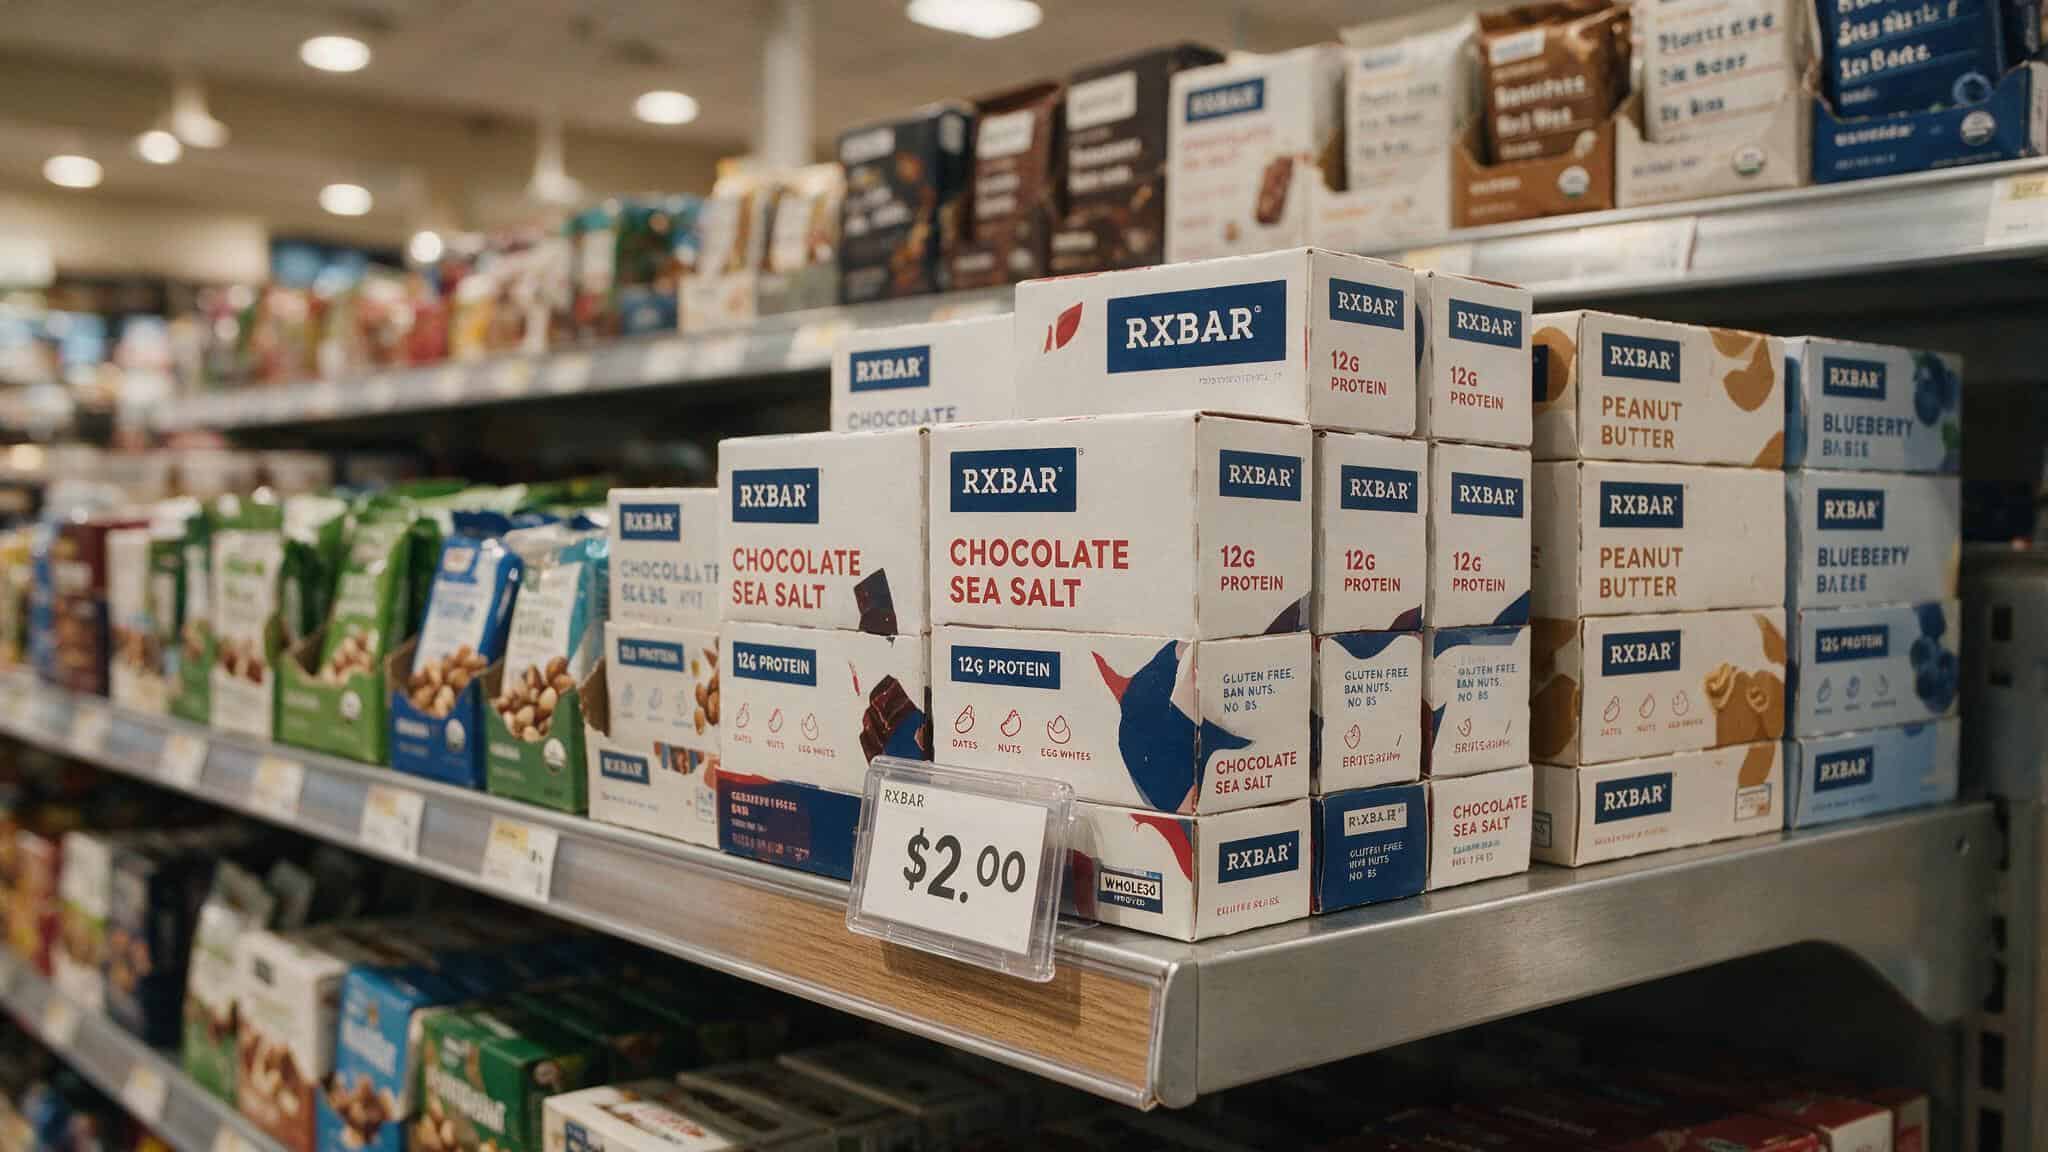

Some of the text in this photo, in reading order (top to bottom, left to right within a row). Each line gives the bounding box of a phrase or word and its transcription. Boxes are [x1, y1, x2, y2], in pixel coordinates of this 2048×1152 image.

[1337, 290, 1397, 318] RXBAR
[1125, 307, 1254, 349] RXBAR
[1456, 310, 1515, 338] RXBAR
[1331, 350, 1359, 372] 12G
[1609, 344, 1672, 371] RXBAR
[855, 356, 921, 383] RXBAR
[1451, 366, 1478, 387] 12G
[1829, 366, 1880, 389] RXBAR
[1331, 377, 1387, 396] PROTEIN
[1451, 391, 1504, 411] PROTEIN
[1601, 395, 1683, 422] PEANUT
[1601, 424, 1675, 449] BUTTER
[962, 466, 1058, 496] RXBAR
[1228, 464, 1292, 488] RXBAR
[740, 484, 808, 507] RXBAR
[1349, 477, 1409, 500] RXBAR
[1459, 485, 1516, 506] RXBAR
[1609, 495, 1675, 516] RXBAR
[1823, 498, 1877, 520] RXBAR
[732, 547, 861, 576] CHOCOLATE
[950, 538, 1129, 569] CHOCOLATE
[1220, 544, 1256, 569] 12G
[1344, 550, 1376, 571] 12G
[1452, 552, 1482, 572] 12G
[1600, 546, 1684, 569] PEANUT
[732, 580, 768, 606] SEA
[775, 583, 825, 609] SALT
[950, 575, 1082, 608] SEA SALT
[1220, 576, 1284, 593] PROTEIN
[1344, 577, 1401, 593] PROTEIN
[1452, 577, 1506, 593] PROTEIN
[1600, 576, 1678, 599] BUTTER
[1840, 633, 1883, 649] PROTEIN
[737, 650, 810, 676] 12G PROTEIN
[1610, 640, 1673, 665] RXBAR
[958, 656, 1051, 678] 12G PROTEIN
[1223, 671, 1264, 684] GLUTEN
[1344, 670, 1383, 681] GLUTEN
[1223, 686, 1244, 698] BAN
[1344, 684, 1364, 694] BAN
[1224, 702, 1239, 713] NO
[1347, 698, 1362, 708] NO
[952, 738, 978, 750] DATES
[998, 743, 1022, 754] NUTS
[1216, 751, 1297, 775] CHOCOLATE
[1215, 775, 1273, 795] SEA SALT
[883, 788, 925, 808] RXBAR
[1453, 794, 1528, 819] CHOCOLATE
[1604, 784, 1664, 812] RXBAR
[1453, 816, 1510, 837] SEA SALT
[1226, 844, 1289, 872] RXBAR
[1105, 876, 1156, 896] WHOLE30
